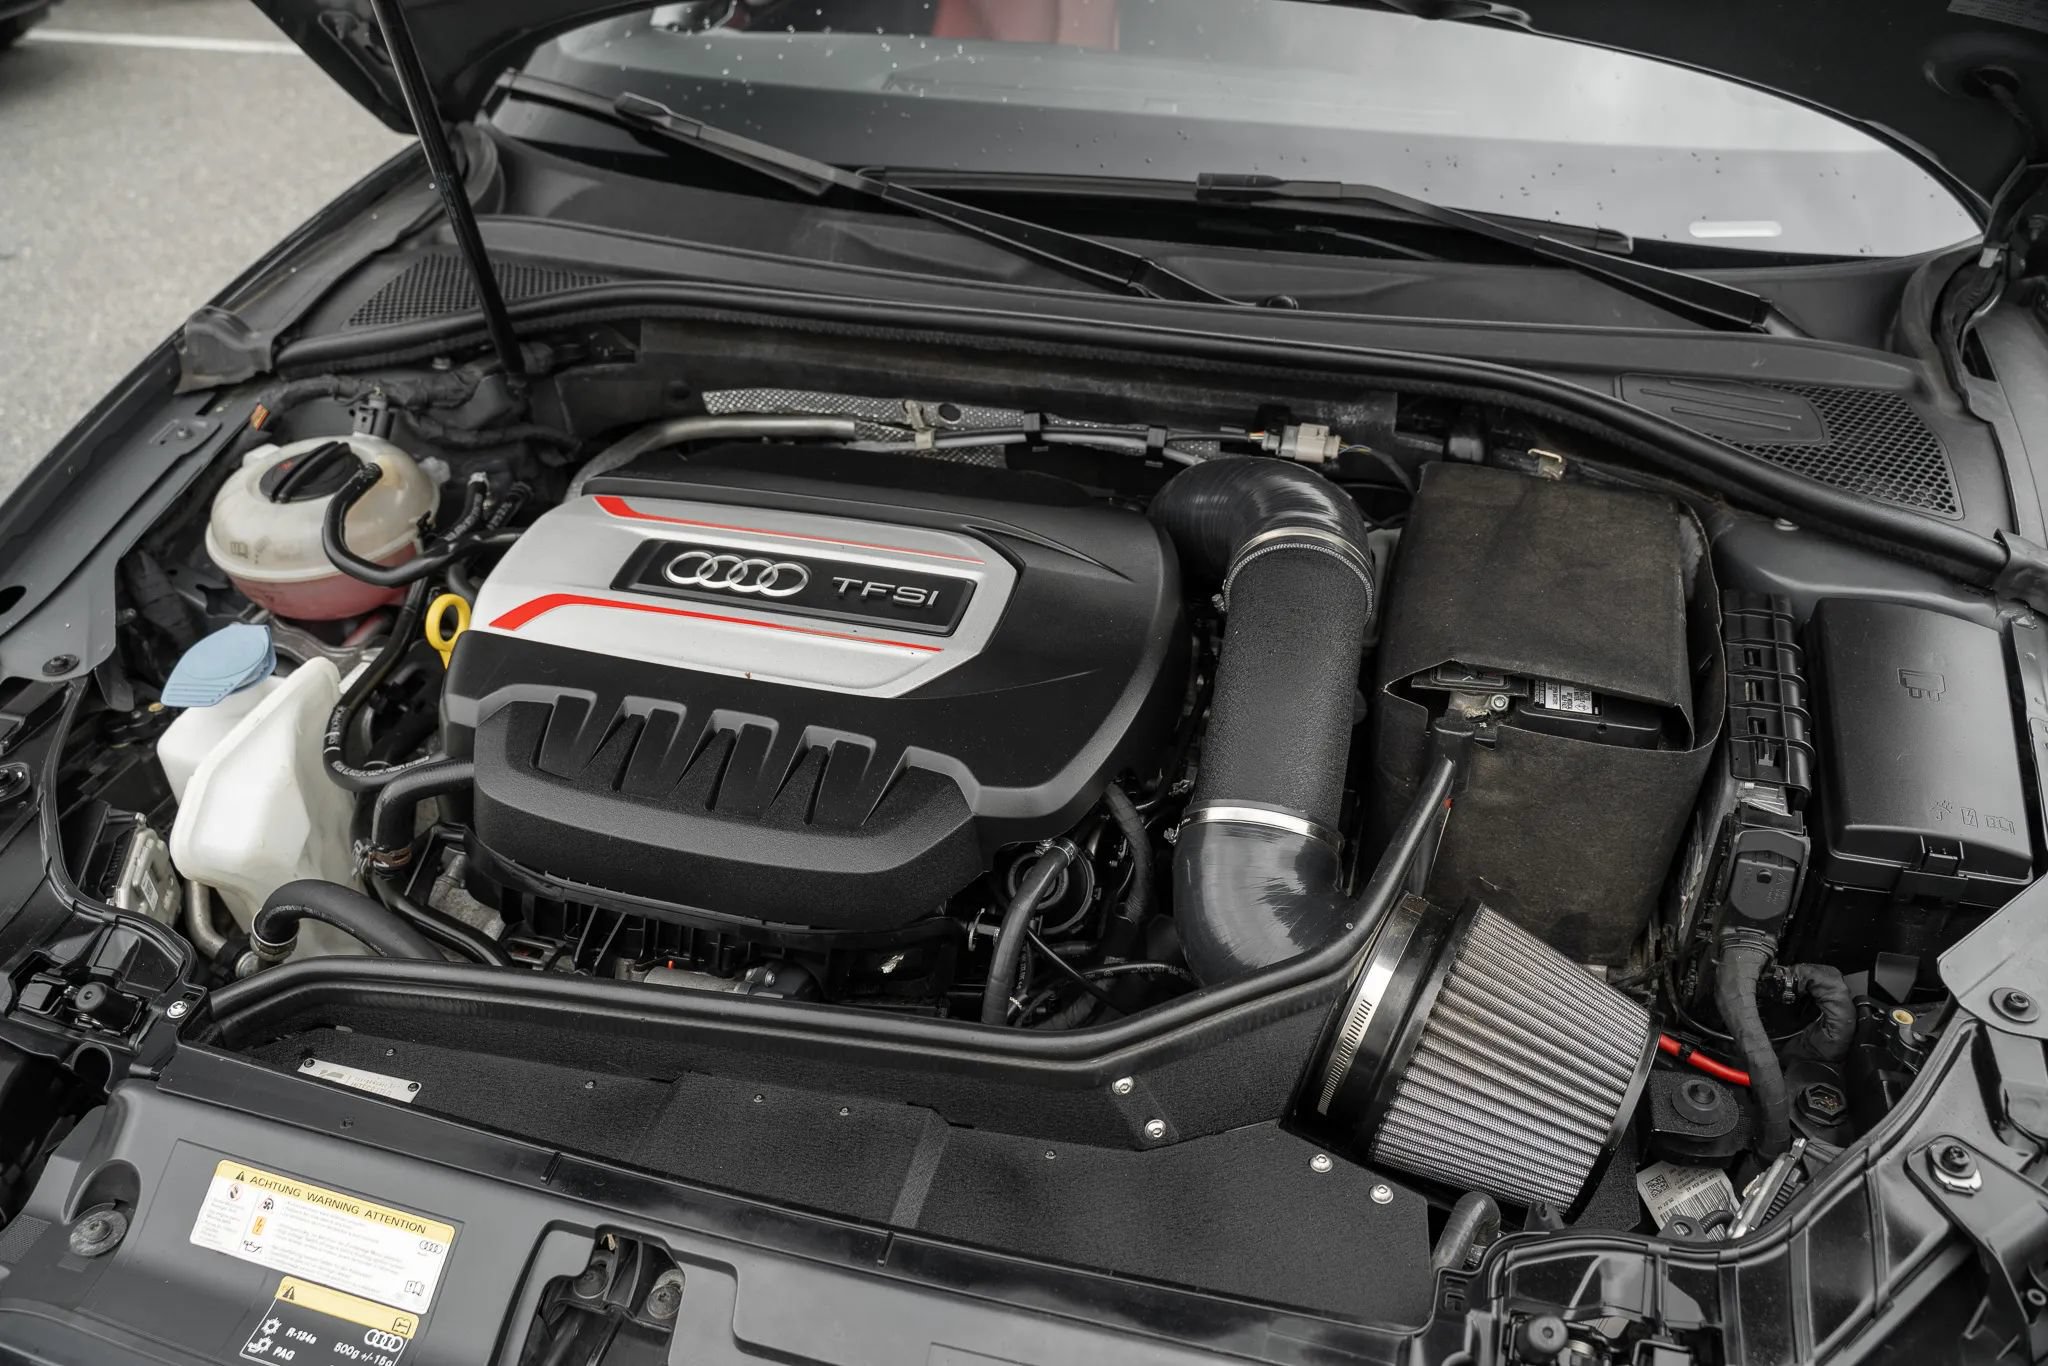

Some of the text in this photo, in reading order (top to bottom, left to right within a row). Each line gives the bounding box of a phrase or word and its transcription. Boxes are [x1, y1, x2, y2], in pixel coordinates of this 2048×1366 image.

[832, 576, 939, 608] TFSI
[249, 1176, 301, 1198] ACHTUNG
[306, 1191, 360, 1216] WARNING
[364, 1209, 427, 1234] ATTENTION
[285, 1327, 317, 1345] R-134a
[272, 1346, 296, 1361] PAG
[333, 1341, 360, 1360] 500g
